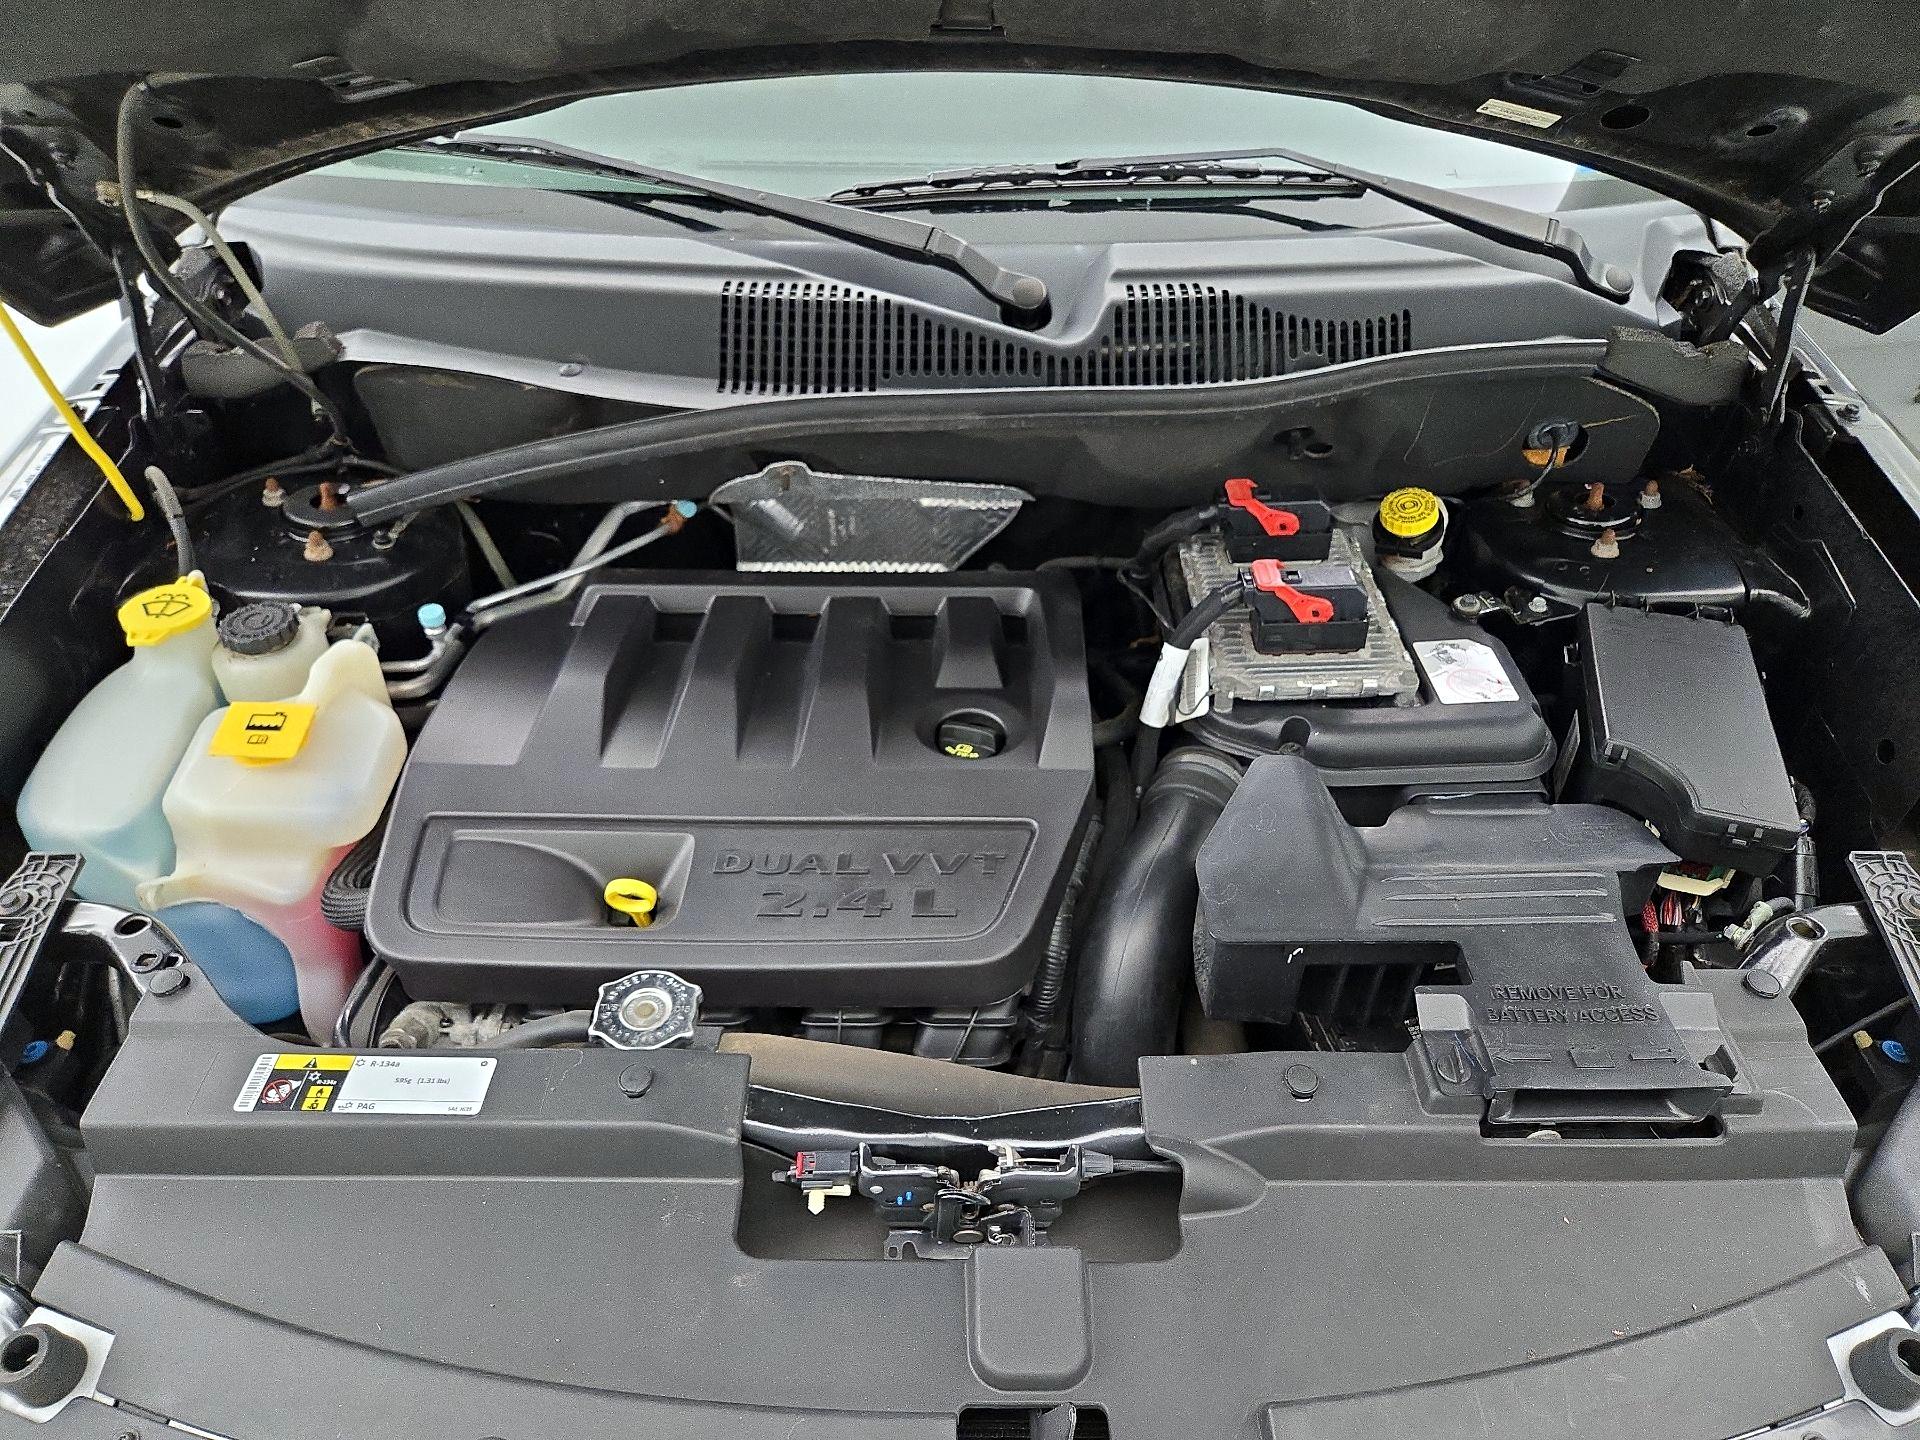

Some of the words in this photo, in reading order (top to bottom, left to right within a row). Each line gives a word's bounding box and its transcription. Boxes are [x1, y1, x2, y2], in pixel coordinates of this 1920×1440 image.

[713, 852, 870, 875] DUAL
[882, 852, 1006, 875] VVT
[1490, 984, 1579, 1001] REMOVE
[1583, 984, 1626, 1000] FOR
[1488, 1008, 1570, 1023] BATTERY
[1575, 1006, 1660, 1023] ACCESS
[417, 1077, 436, 1085] (1.31
[437, 1077, 451, 1085] lbs)
[357, 1102, 376, 1111] PAG
